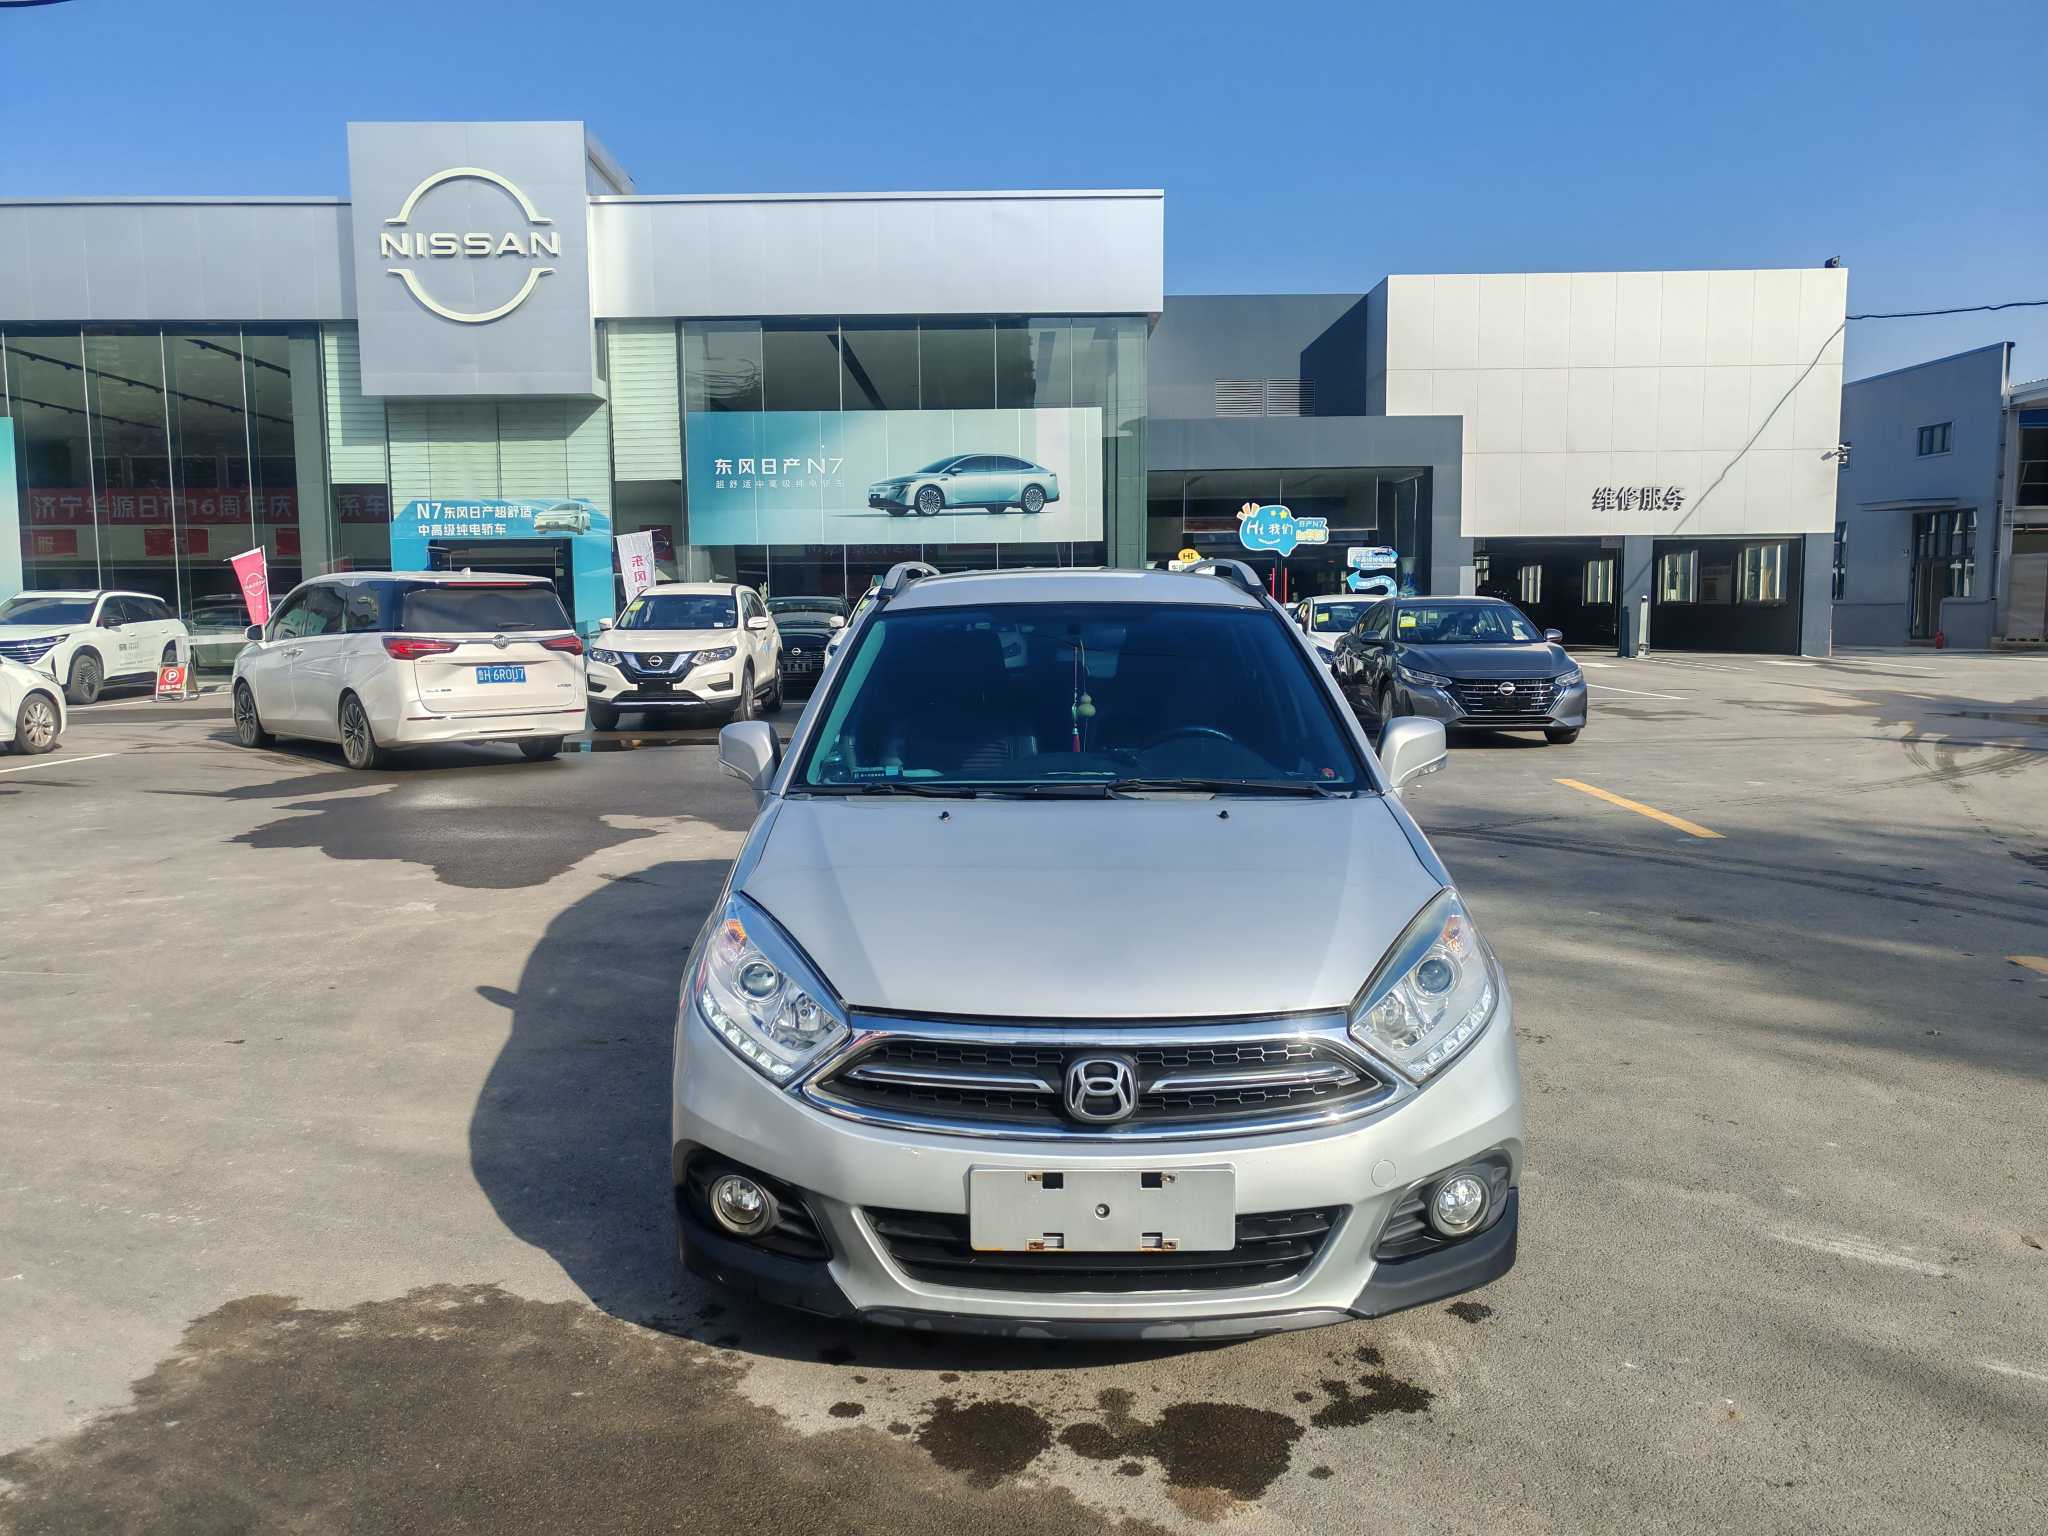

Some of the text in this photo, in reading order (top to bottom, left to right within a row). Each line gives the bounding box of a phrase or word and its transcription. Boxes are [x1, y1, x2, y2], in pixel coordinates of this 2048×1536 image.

[379, 232, 561, 257] NISSAN
[714, 458, 844, 475] 东风日产 N7
[1592, 486, 1685, 511] 维修服务
[416, 503, 533, 520] N7 东风日产超舒适
[418, 524, 507, 536] 中高级纯电轿车
[1246, 521, 1264, 535] Hi
[632, 555, 647, 593] 东风
